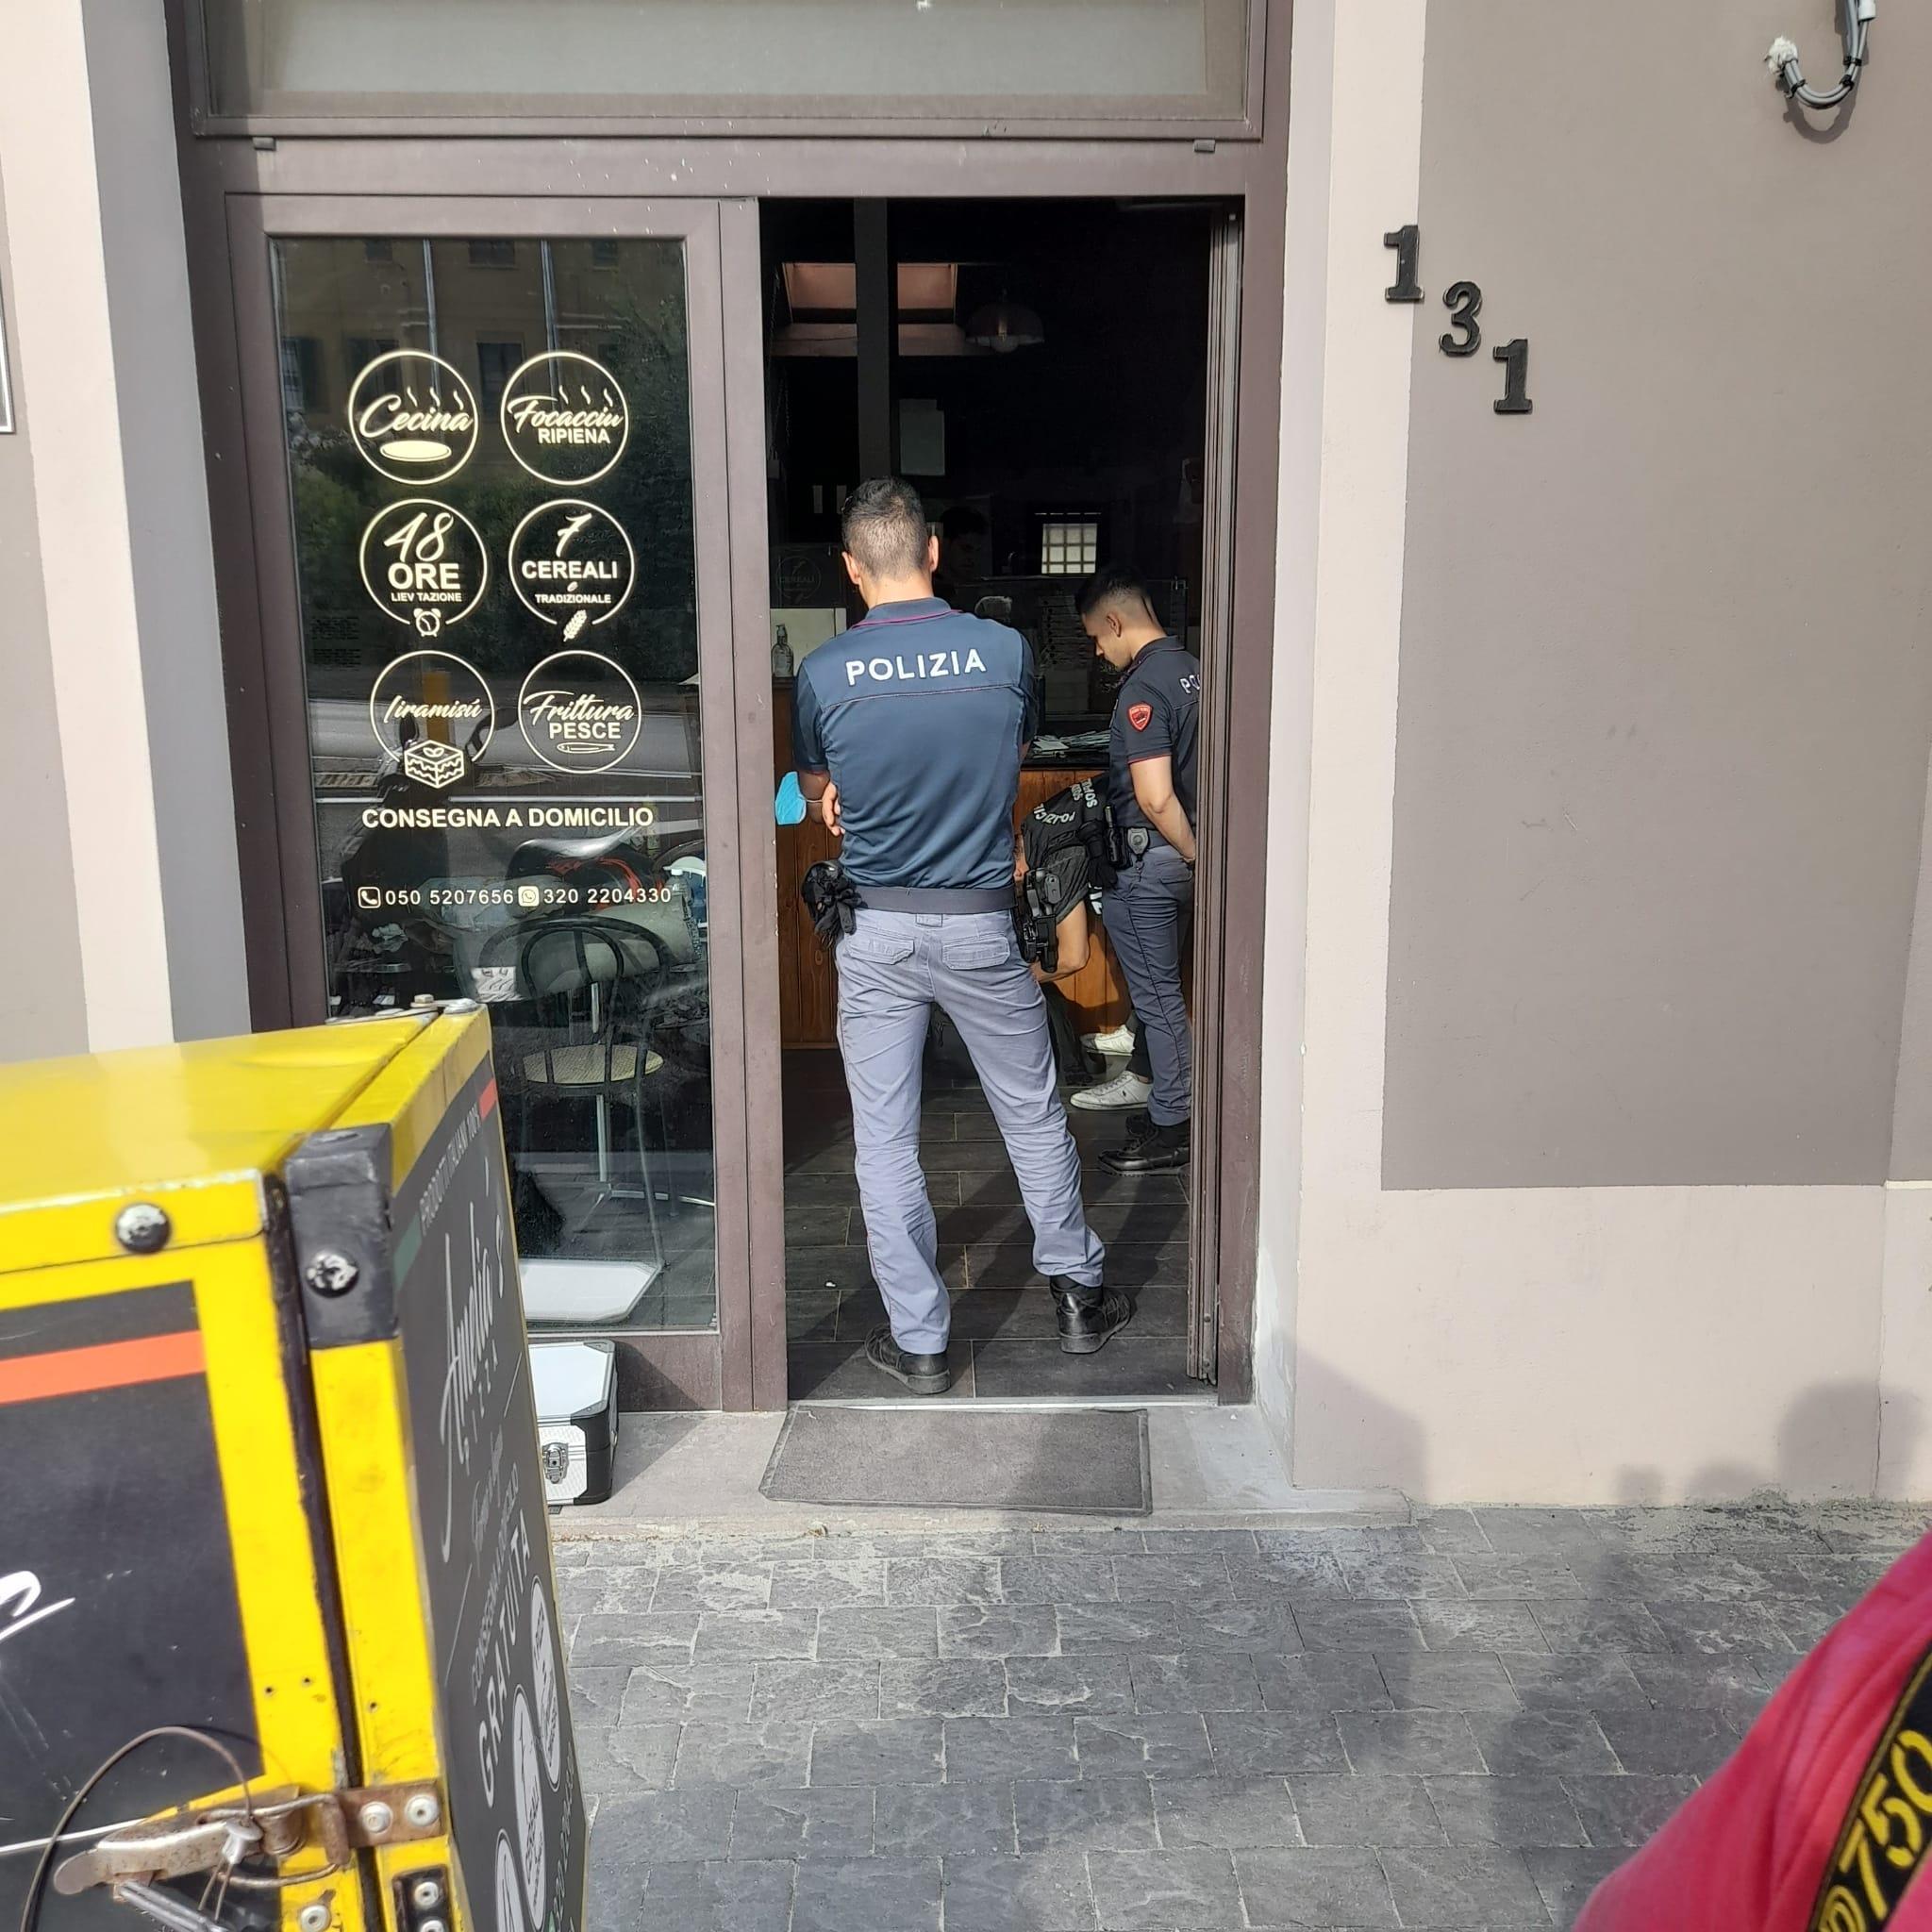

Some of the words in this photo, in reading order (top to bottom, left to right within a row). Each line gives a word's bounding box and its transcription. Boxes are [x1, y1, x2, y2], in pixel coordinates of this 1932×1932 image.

[359, 393, 474, 439] Cecina
[538, 427, 611, 444] RIPIENA
[383, 512, 454, 562] 48
[556, 512, 592, 558] 7
[388, 562, 461, 590] ORE
[522, 560, 618, 579] CEREALI
[534, 593, 612, 604] TRADIZIONALE
[845, 648, 987, 687] POLIZIA
[523, 691, 634, 725] Frittura
[549, 722, 621, 740] PESCE
[362, 808, 501, 828] CONSEGNA
[505, 808, 523, 827] A
[528, 808, 653, 827] DOMICILIO
[385, 890, 421, 905] 050
[430, 889, 514, 906] 5207656
[543, 889, 578, 904] 320
[588, 888, 672, 904] 2204330
[479, 1508, 530, 1808] GRATUITA
